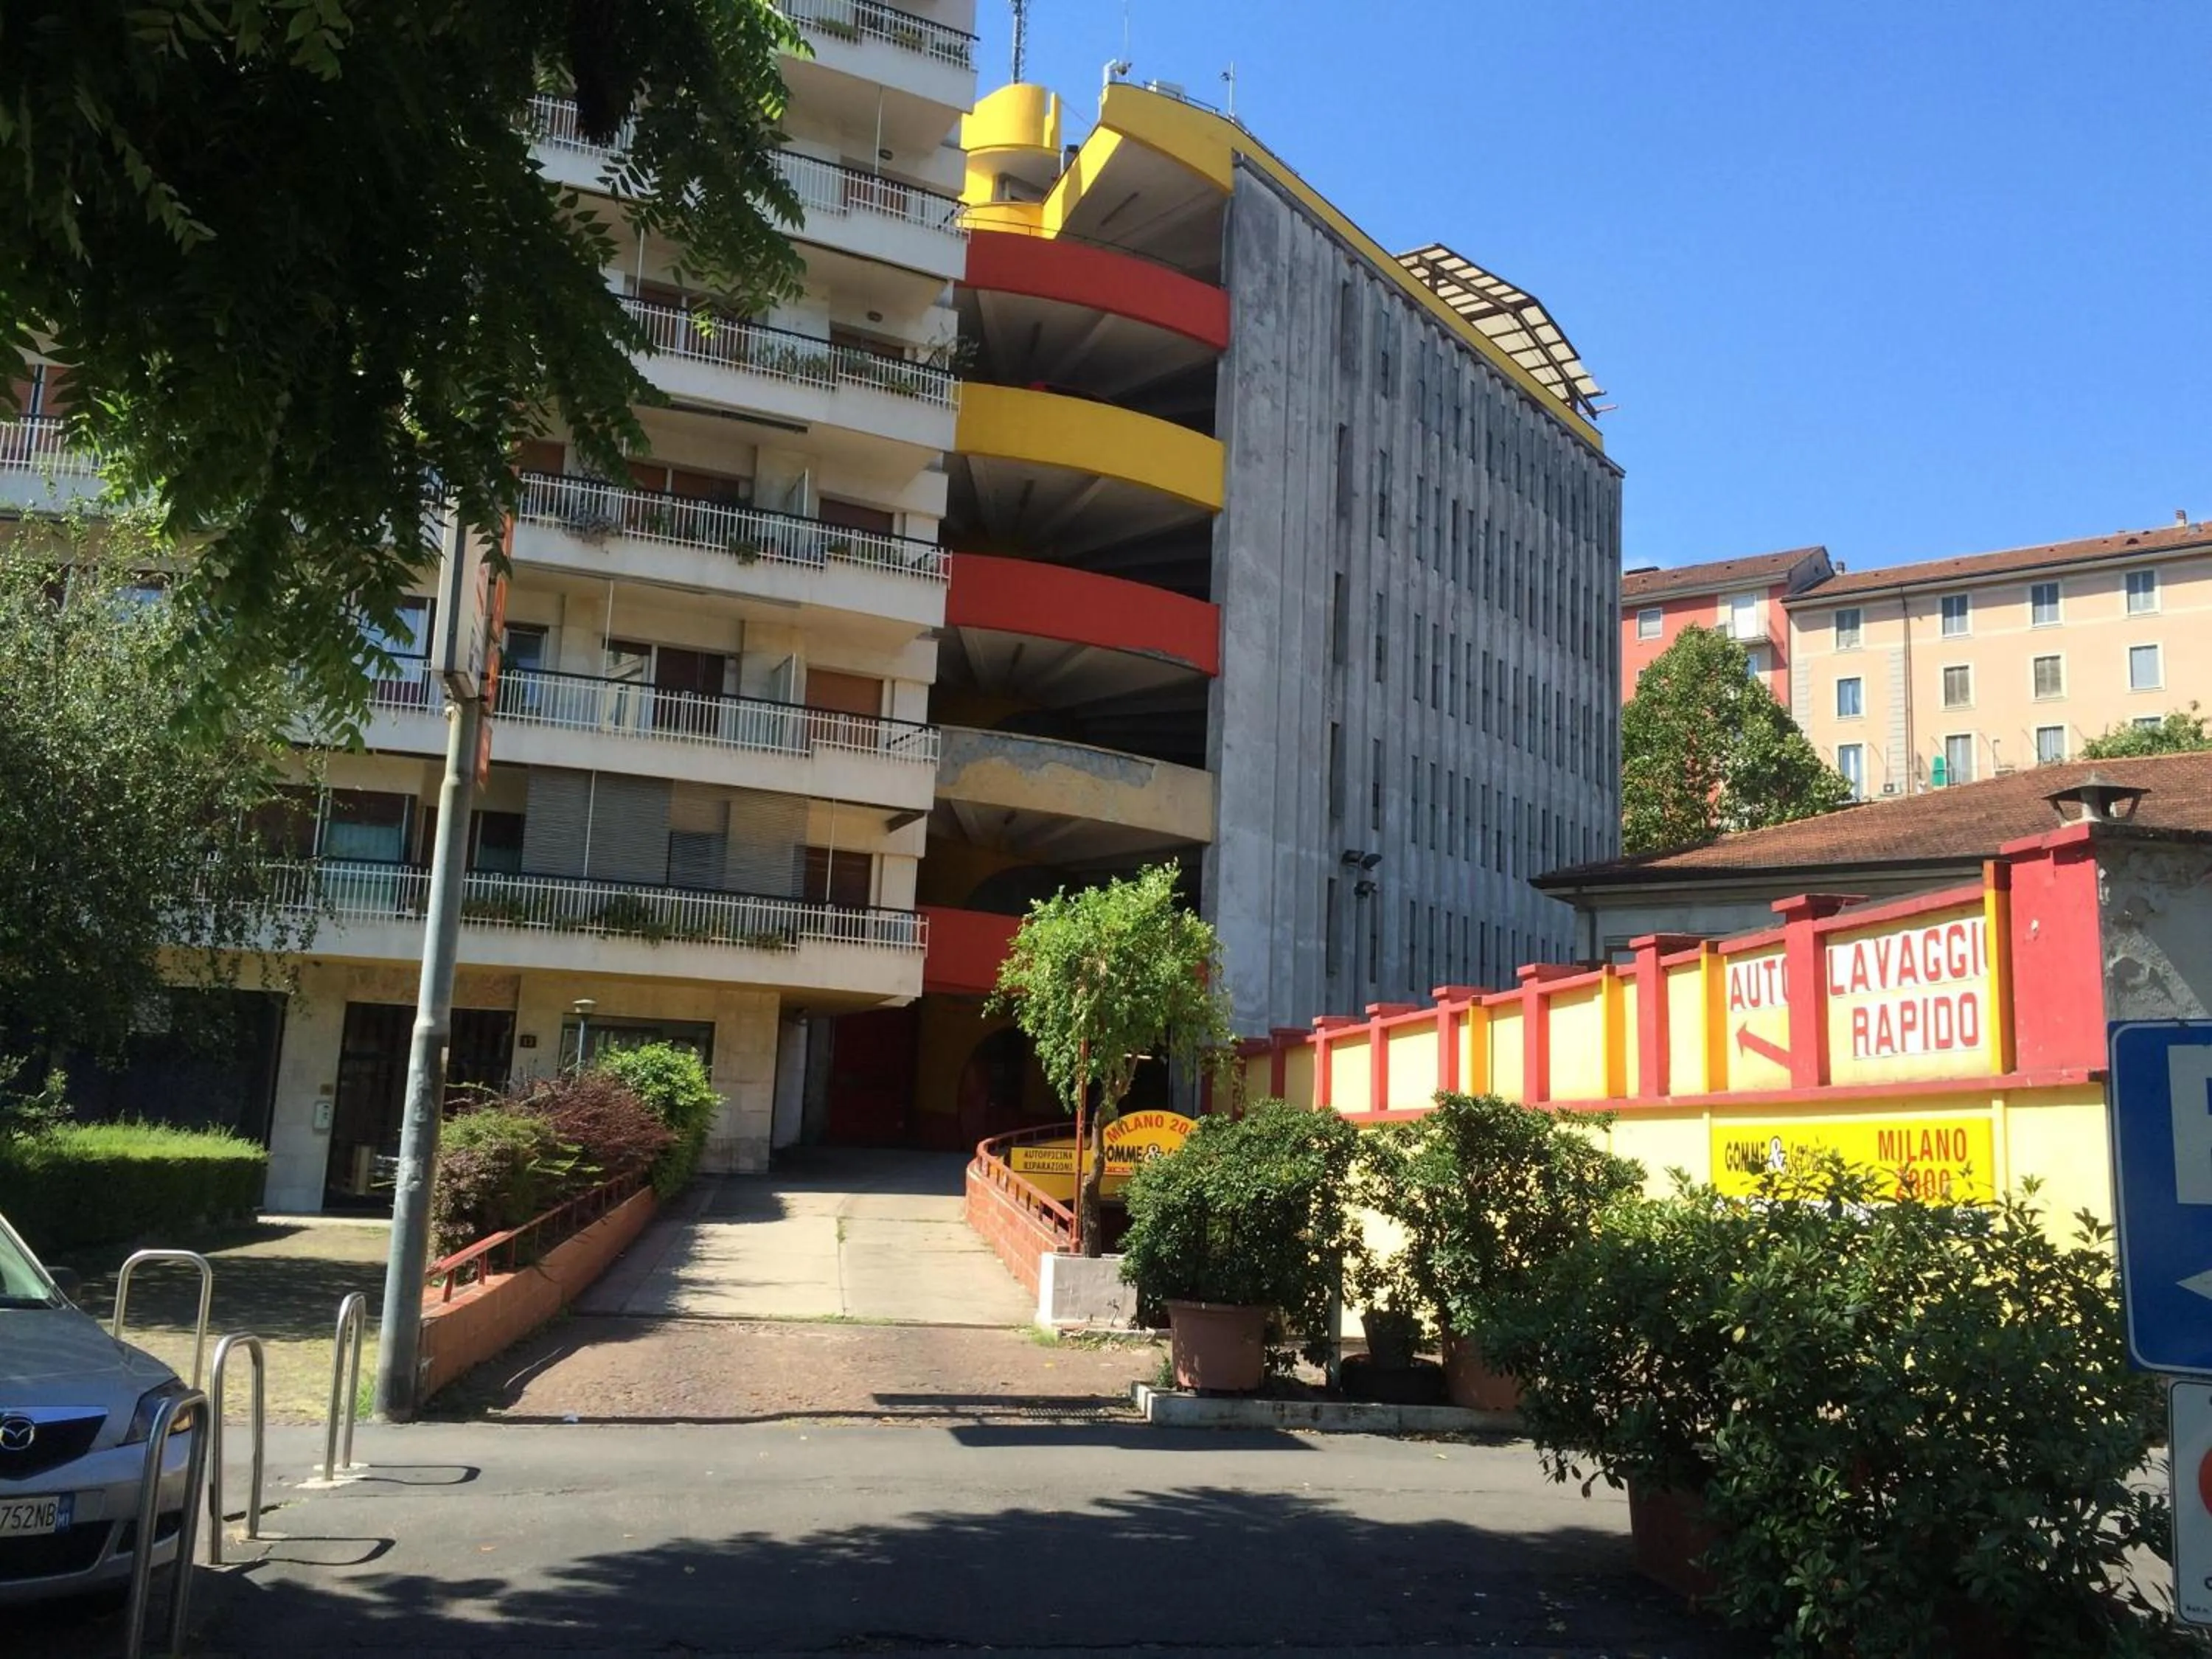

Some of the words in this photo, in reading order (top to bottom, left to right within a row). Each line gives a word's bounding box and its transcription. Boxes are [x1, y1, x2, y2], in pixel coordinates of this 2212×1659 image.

[1829, 922, 1989, 996] LAVAGGI
[1853, 992, 1979, 1056] RAPIDO
[1107, 1114, 1164, 1143] MILANO
[1169, 1118, 1193, 1135] 20
[1878, 1127, 1967, 1162] MILANO
[1106, 1144, 1142, 1164] OMME
[1767, 1135, 1787, 1175] &
